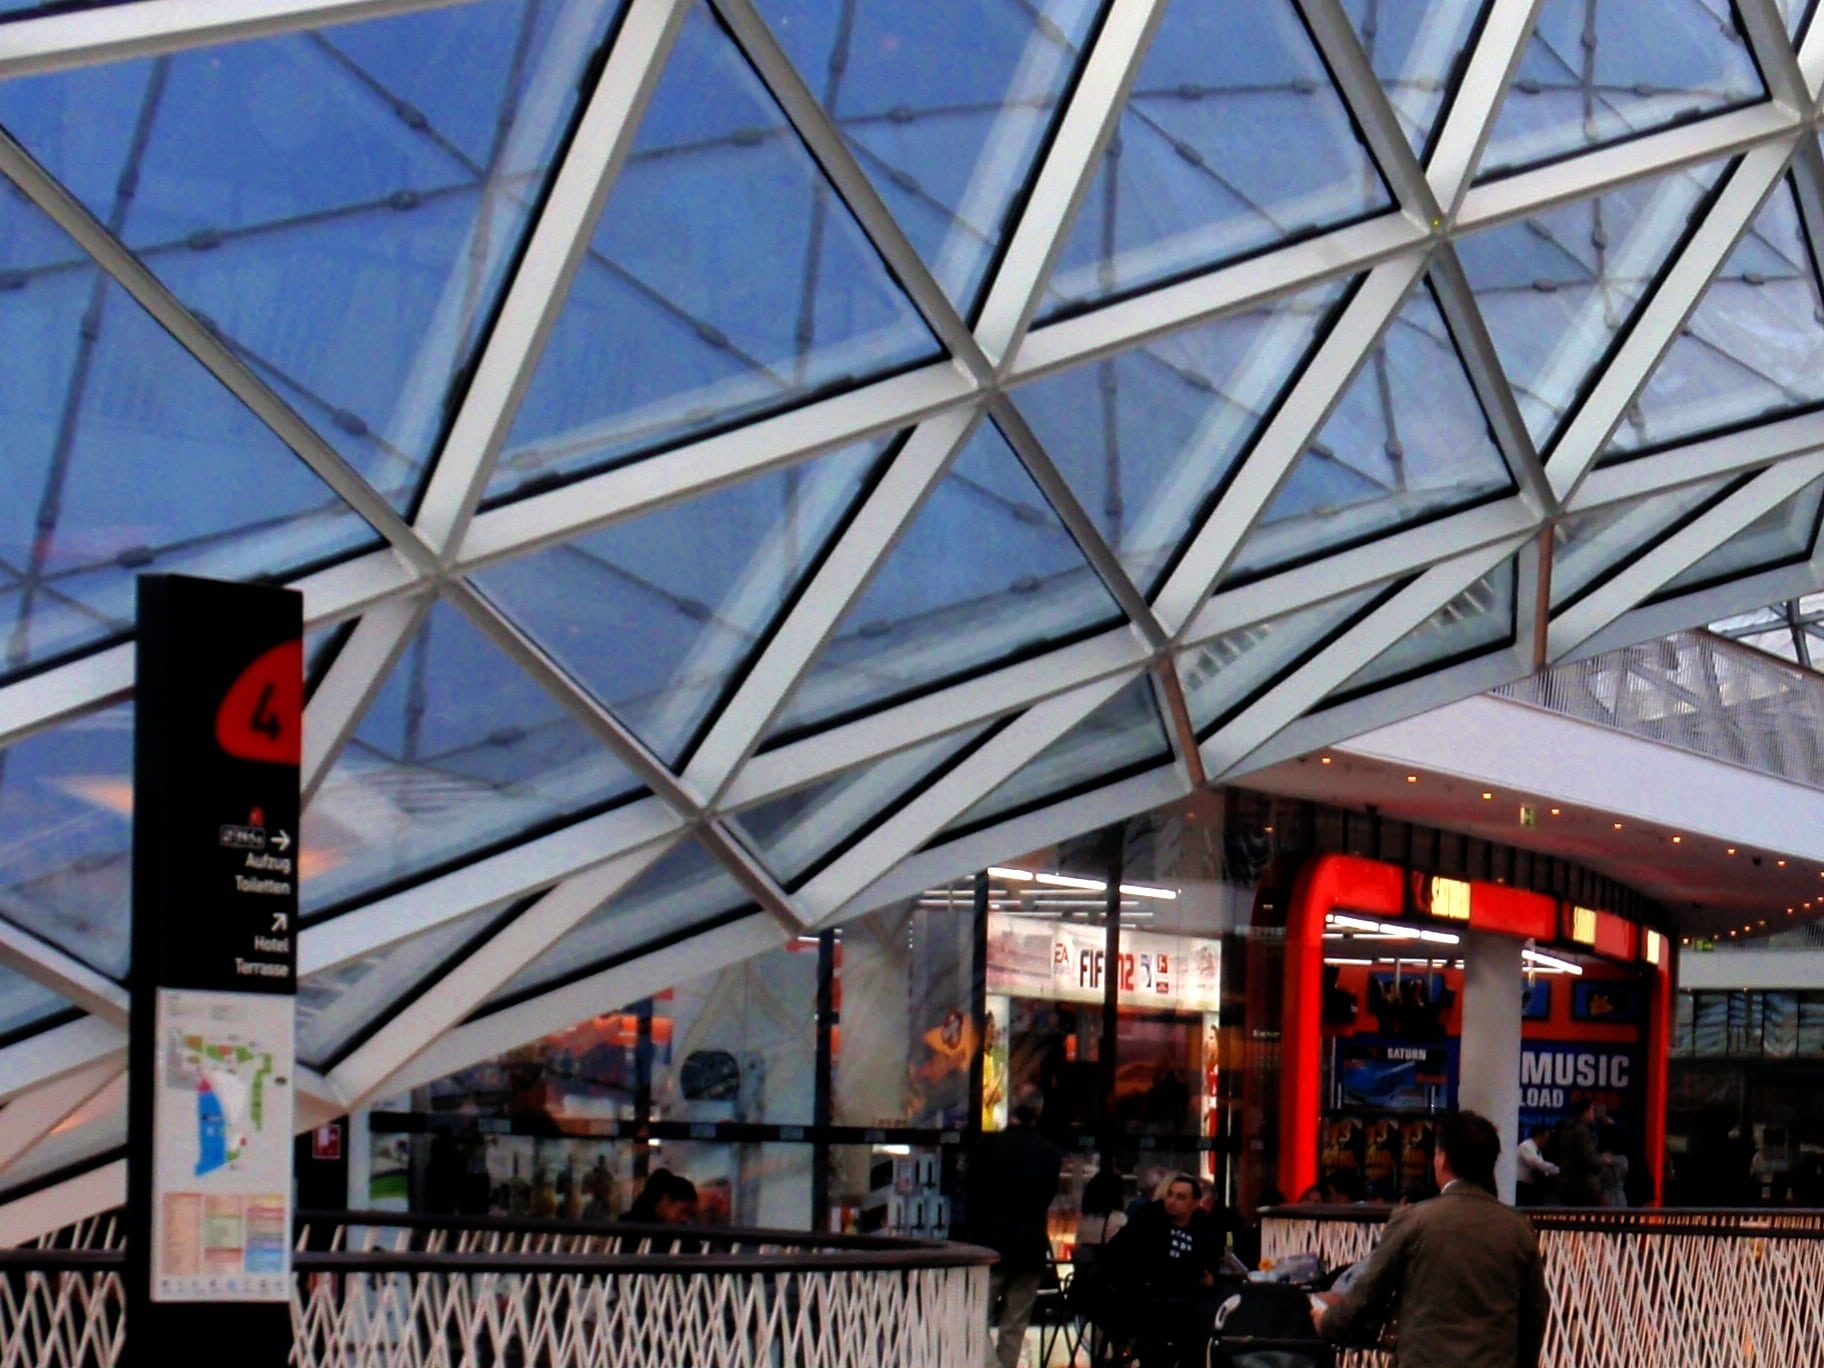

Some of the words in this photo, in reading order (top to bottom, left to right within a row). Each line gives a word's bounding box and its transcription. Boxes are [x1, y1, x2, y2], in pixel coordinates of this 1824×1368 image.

[252, 682, 280, 742] 4
[245, 852, 292, 875] Aufzug
[235, 874, 291, 896] Toiletten
[253, 935, 291, 953] Hotel
[1054, 943, 1069, 963] EA
[235, 957, 290, 979] Terrasse
[1080, 949, 1105, 989] FIF
[1387, 1047, 1427, 1061] SATURN
[1521, 1051, 1630, 1088] MUSIC
